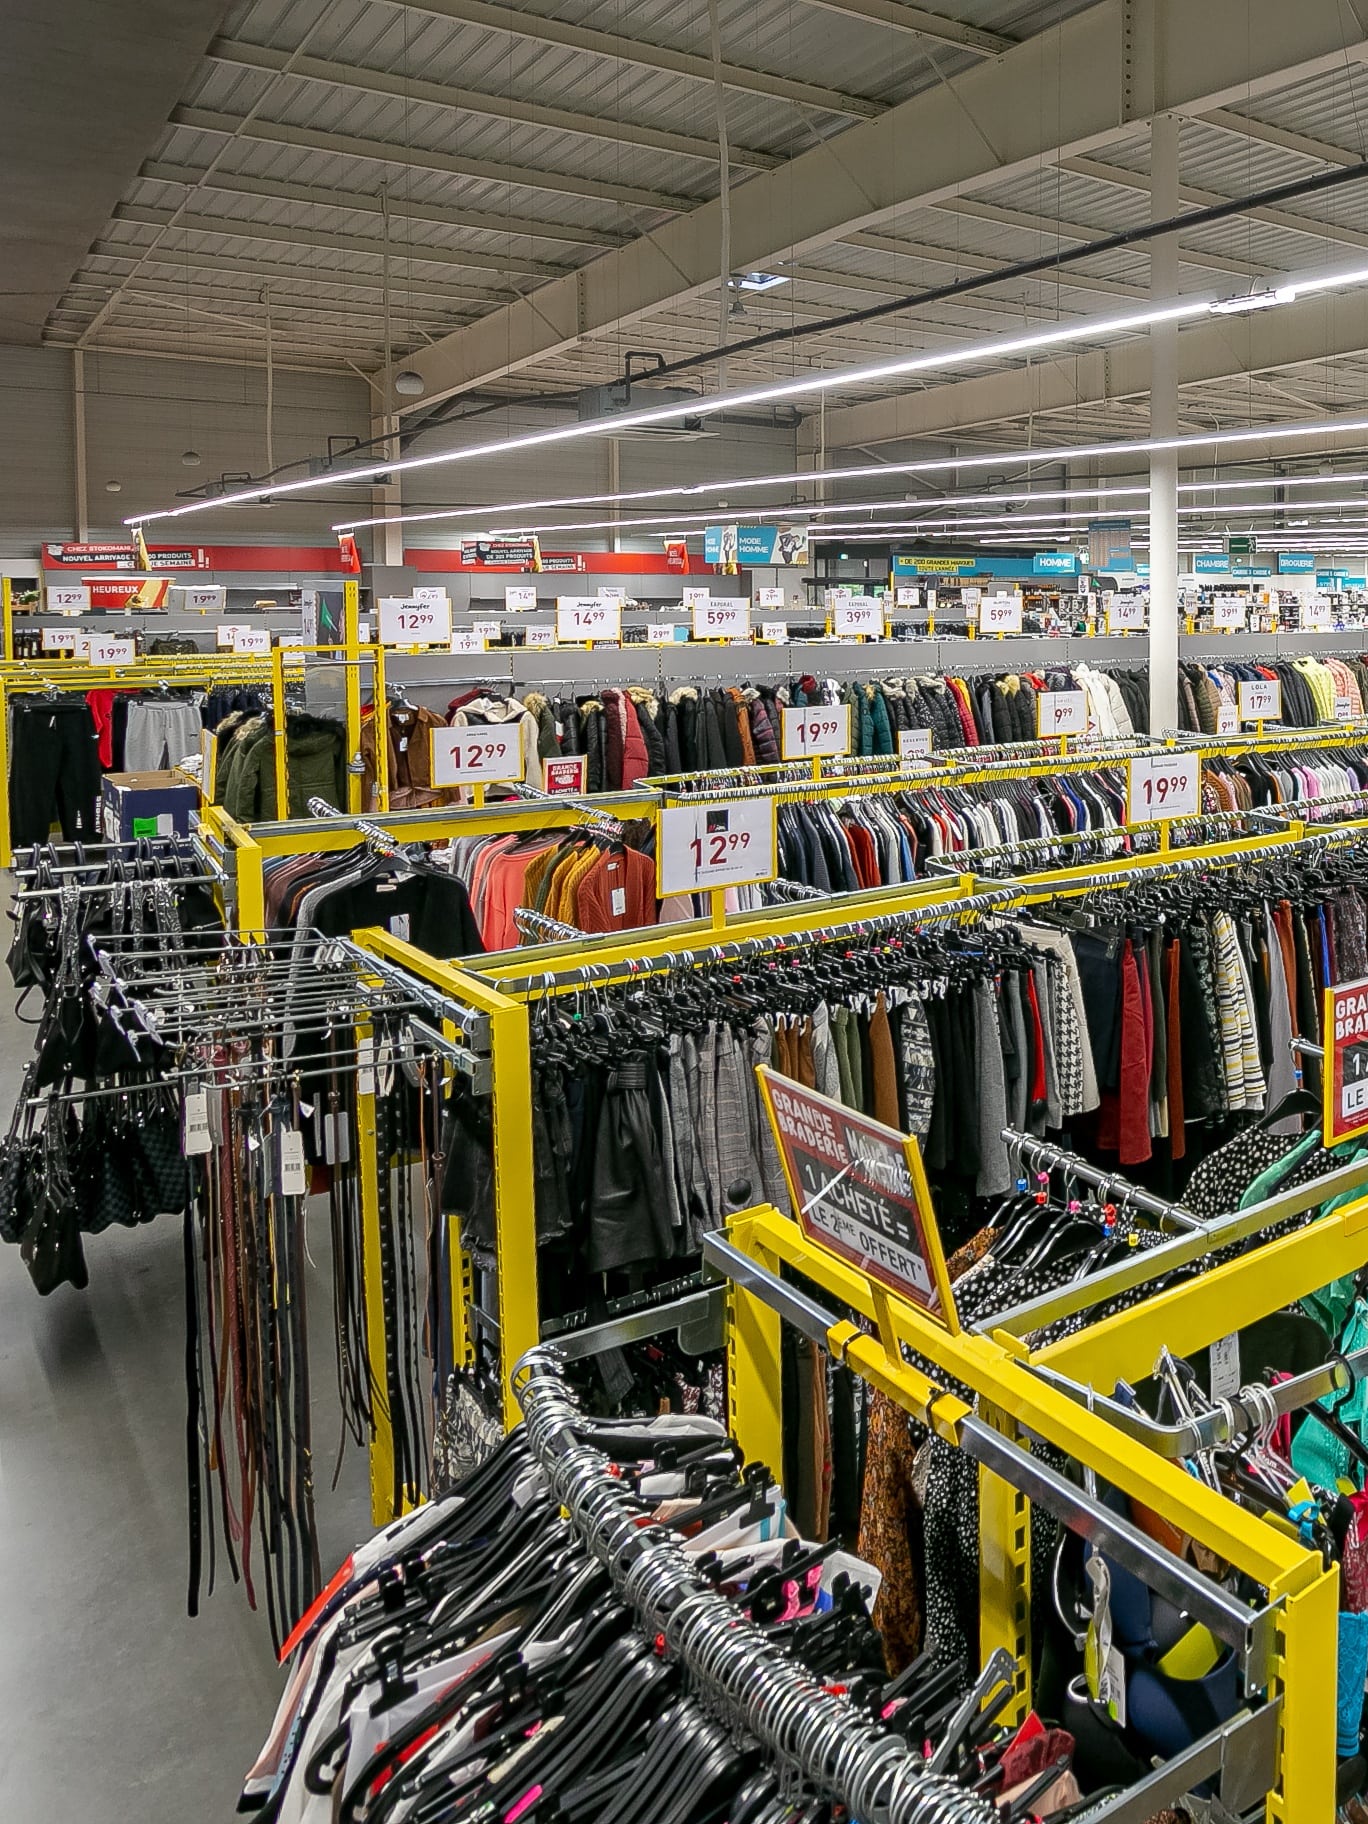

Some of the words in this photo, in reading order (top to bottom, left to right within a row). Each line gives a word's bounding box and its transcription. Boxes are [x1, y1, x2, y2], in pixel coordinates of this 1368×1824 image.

[739, 546, 769, 554] HOMME
[1039, 557, 1071, 568] HOMME
[1196, 559, 1229, 569] CHAMBRE
[1280, 559, 1314, 568] DROGUERIE
[92, 585, 139, 594] HEUREUX
[56, 594, 82, 604] 1299
[192, 595, 217, 604] 1999
[397, 614, 434, 630] 1299
[573, 611, 605, 626] 1499
[707, 611, 736, 625] 5999
[846, 611, 871, 623] 3999
[990, 609, 1012, 621] 5999
[531, 632, 550, 641] 2999
[653, 630, 670, 639] 2999
[240, 638, 263, 647] 1999
[98, 647, 127, 660] 1999
[1249, 695, 1272, 710] 1799
[1054, 707, 1073, 724] 999
[796, 721, 838, 743] 1999
[449, 743, 507, 769] 1299
[1143, 775, 1188, 806] 1999
[689, 832, 751, 868] 1299
[1353, 1055, 1360, 1076] 1
[1347, 1087, 1364, 1109] LE
[771, 1087, 836, 1139] GRANDE
[778, 1111, 849, 1166] BRADERIE
[805, 1164, 817, 1189] 1
[819, 1170, 896, 1236] ACHETÉ
[812, 1205, 828, 1226] LE
